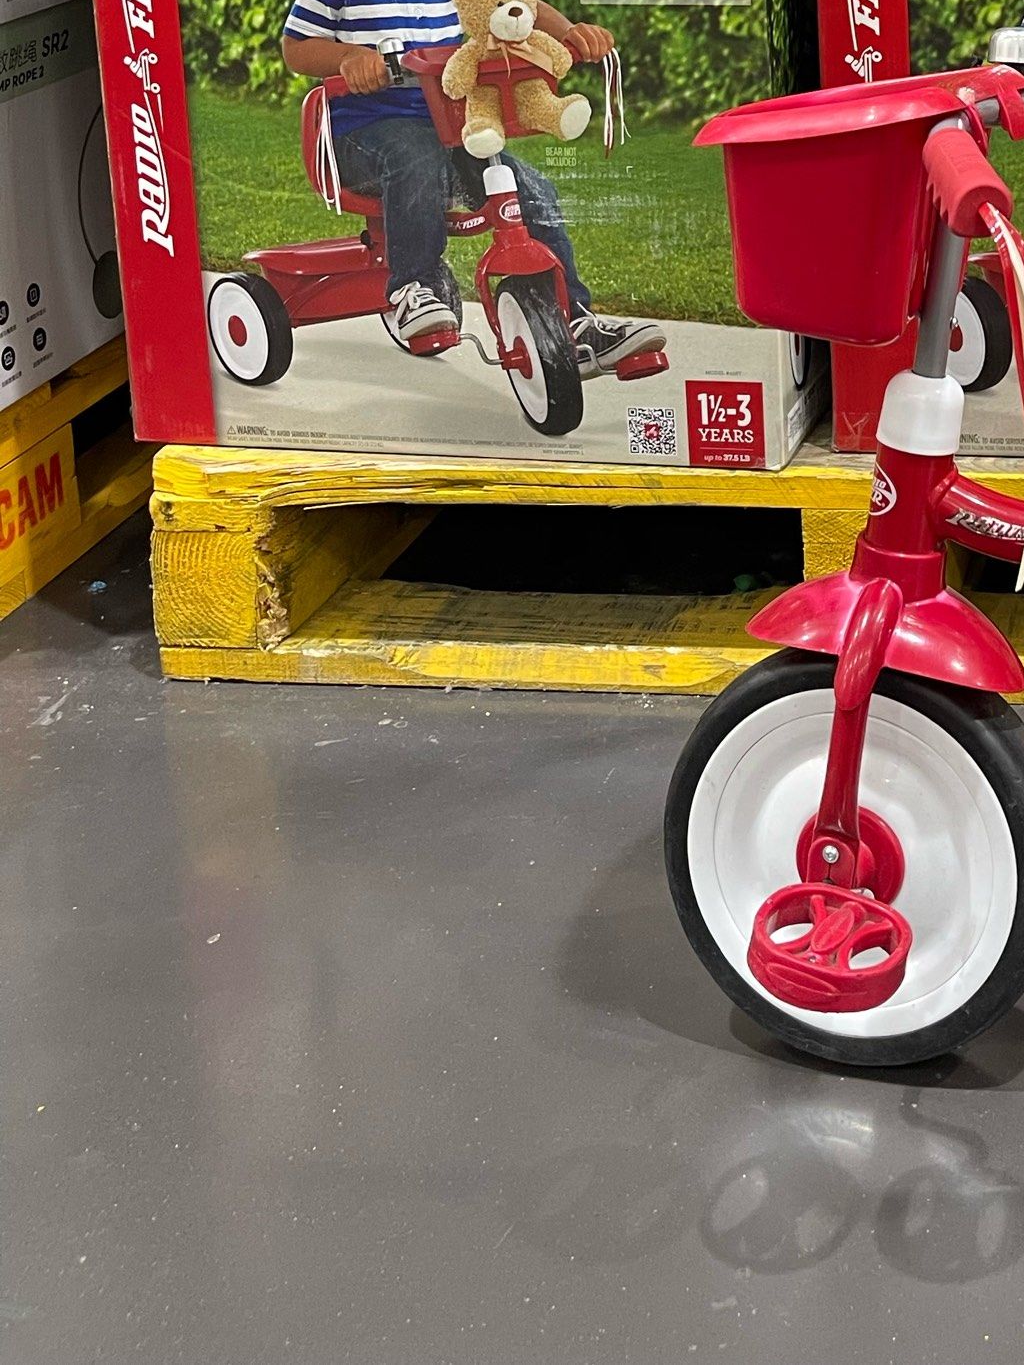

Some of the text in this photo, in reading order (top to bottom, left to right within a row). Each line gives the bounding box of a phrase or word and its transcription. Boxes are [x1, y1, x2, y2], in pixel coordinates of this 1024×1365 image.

[41, 29, 70, 58] SR2
[12, 67, 37, 88] ROPE
[545, 146, 577, 157] BEAR NOT
[545, 157, 577, 167] INCLUDED
[131, 93, 174, 257] RADIO
[698, 428, 754, 443] YEARS
[723, 454, 739, 462] 37.5
